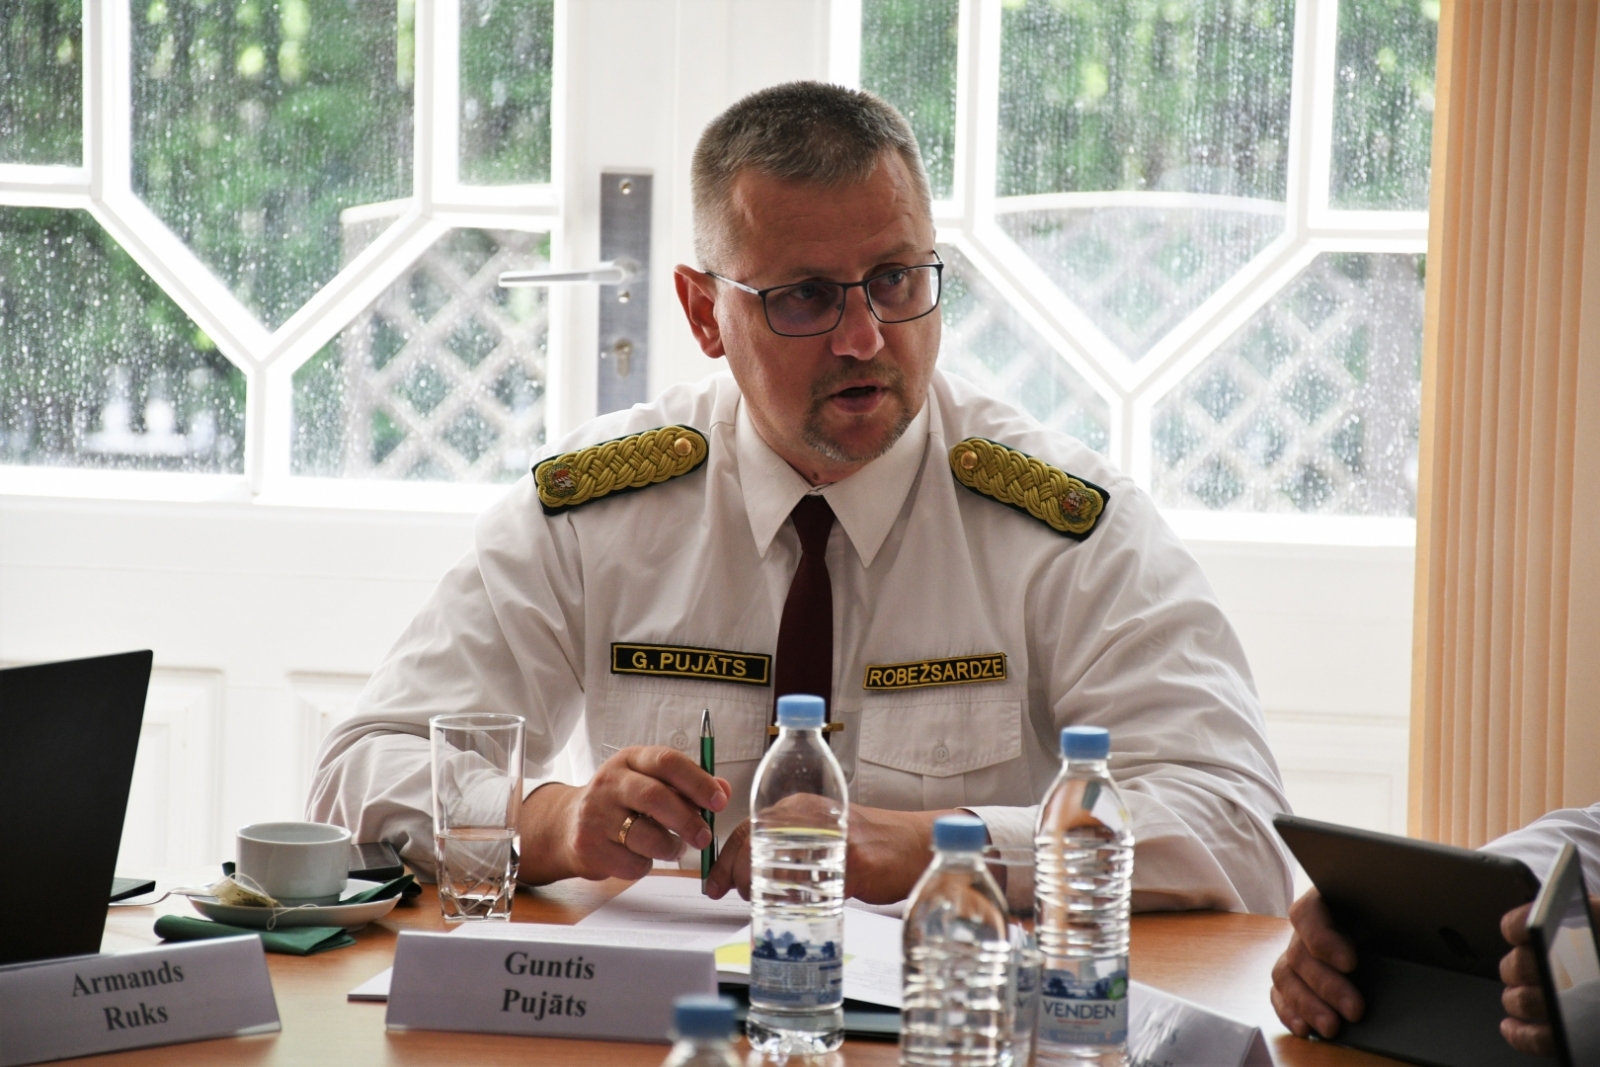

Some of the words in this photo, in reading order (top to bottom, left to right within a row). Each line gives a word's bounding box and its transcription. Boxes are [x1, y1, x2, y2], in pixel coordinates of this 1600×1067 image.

[632, 651, 655, 669] G.
[659, 652, 747, 677] PUJĀTS
[869, 658, 1003, 686] ROBEŽSARDZE
[72, 960, 185, 997] Armands
[504, 951, 595, 980] Guntis
[103, 1002, 169, 1031] Ruks
[501, 988, 587, 1021] Pujāts
[1042, 1000, 1117, 1019] VENDEN
